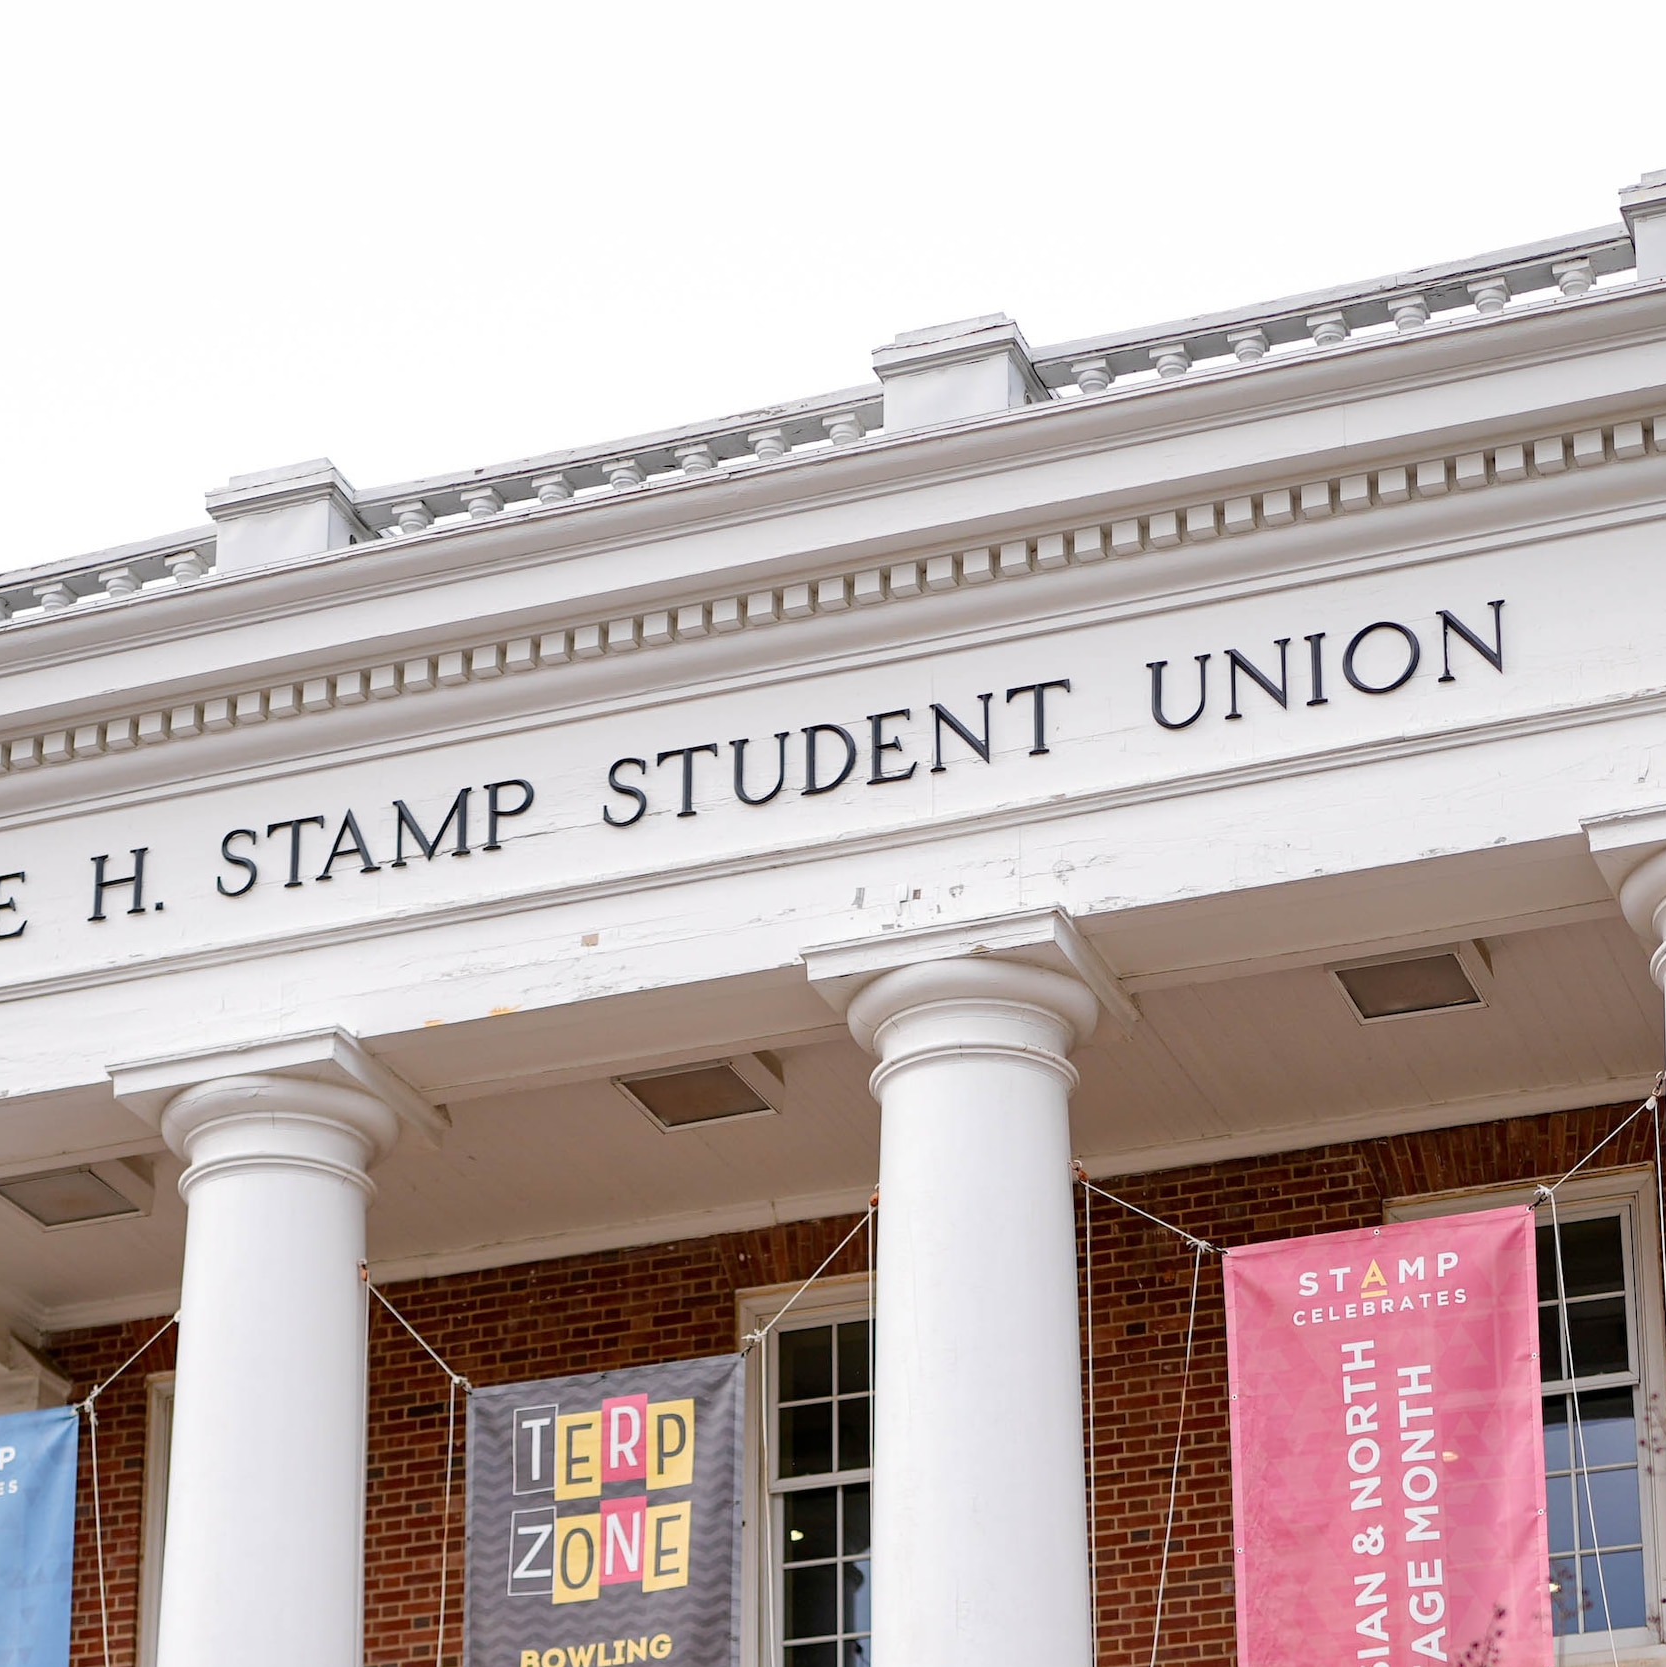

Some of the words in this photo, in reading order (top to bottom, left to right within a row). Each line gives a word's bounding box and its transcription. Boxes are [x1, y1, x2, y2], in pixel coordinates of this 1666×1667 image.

[86, 846, 164, 922] H.
[216, 778, 535, 898] STAMP
[602, 678, 1072, 828] STUDENT
[1145, 599, 1506, 731] UNION
[1292, 1288, 1468, 1327] CELEBRATES
[1298, 1251, 1459, 1297] STAMP
[519, 1403, 688, 1486] TERP
[1341, 1339, 1382, 1511] NORTH
[1397, 1364, 1440, 1543] MONTH
[512, 1511, 681, 1590] ZONE
[1351, 1524, 1385, 1556] &
